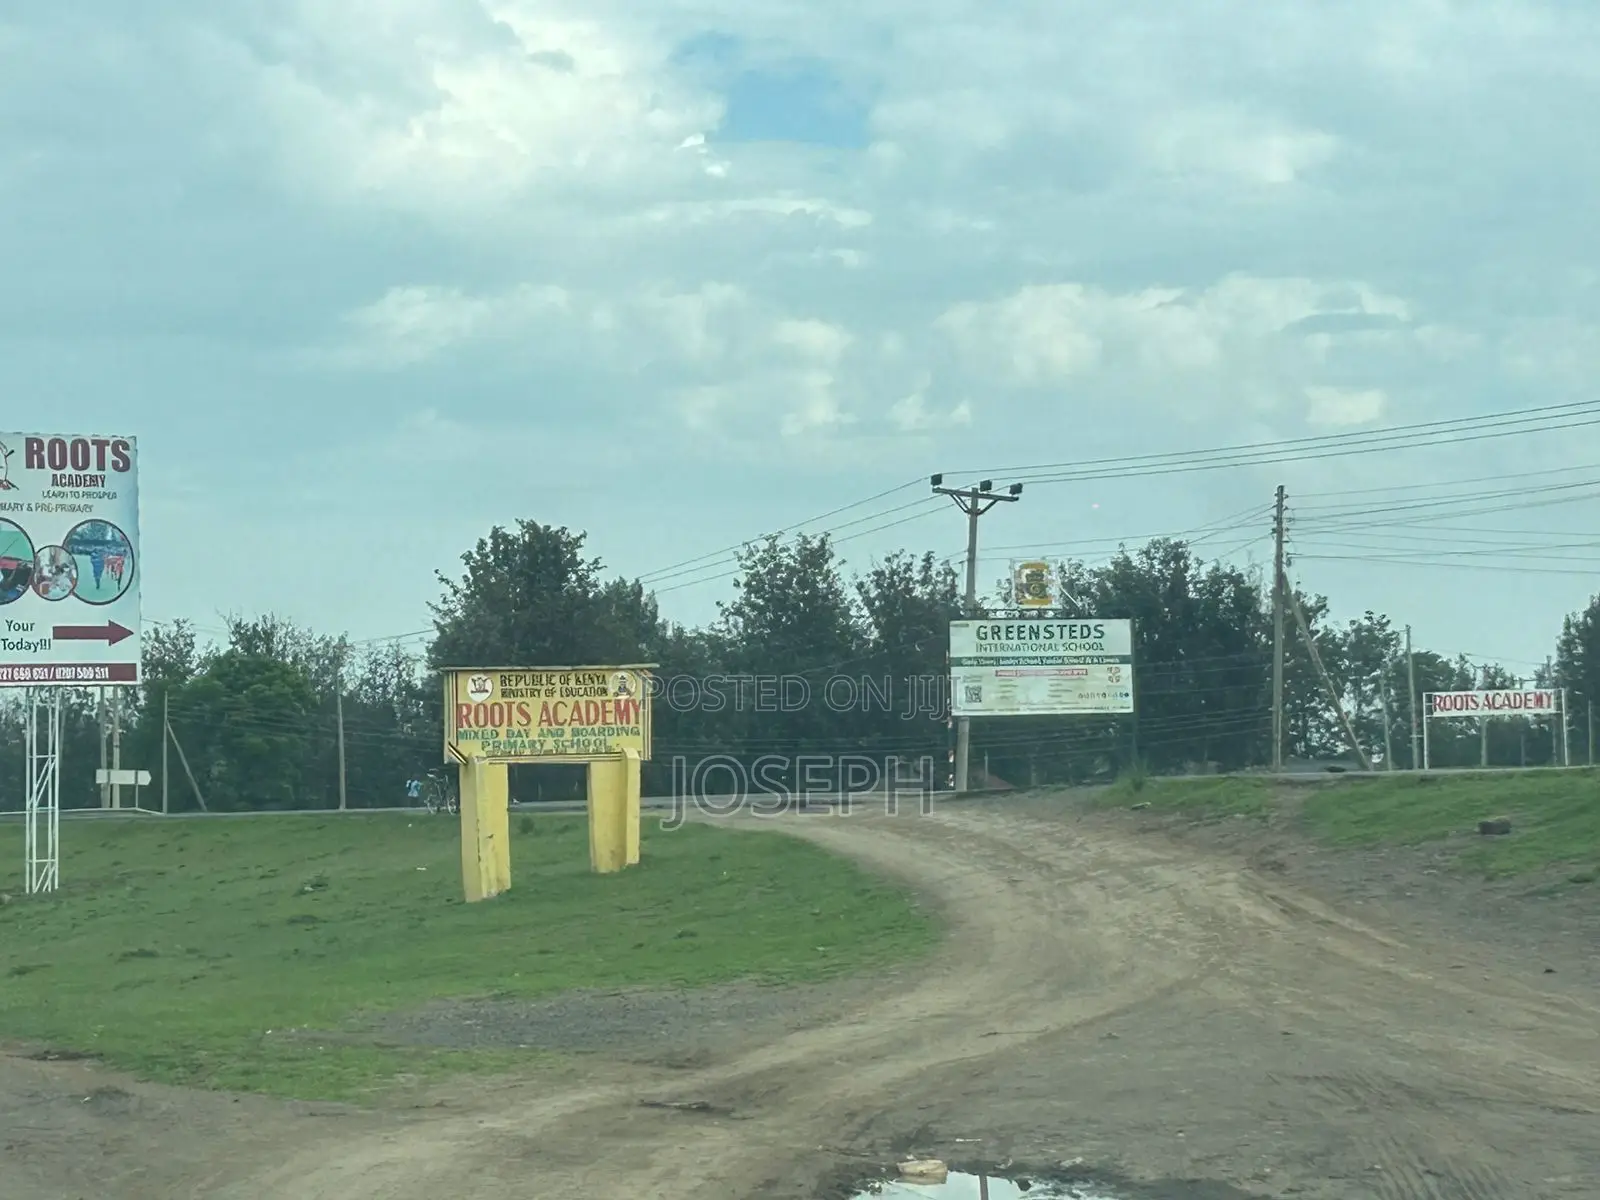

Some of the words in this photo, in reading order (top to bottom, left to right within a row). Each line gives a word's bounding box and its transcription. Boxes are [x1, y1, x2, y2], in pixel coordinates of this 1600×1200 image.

[25, 437, 131, 472] ROOTS
[51, 474, 106, 488] ACADEMY
[69, 490, 80, 499] TO
[26, 502, 33, 512] &
[5, 619, 35, 632] Your
[976, 624, 1105, 640] GREENSTEDS
[1, 637, 51, 653] Today!!!
[976, 642, 1059, 653] INTERNATIONAL
[1062, 641, 1105, 652] SCHOOL
[500, 674, 556, 687] REPUBLIC
[559, 674, 571, 686] OF
[575, 673, 607, 685] KENYA
[501, 688, 541, 698] MINISTRY
[545, 687, 557, 698] OF
[560, 687, 608, 698] EDUCATION
[1434, 694, 1479, 712] ROOTS
[1482, 692, 1553, 711] ACADEMY
[457, 701, 532, 728] ROOTS
[538, 698, 641, 727] ACADEMY
[458, 729, 498, 740] MIXED
[506, 728, 531, 739] DAY
[538, 728, 565, 738] AND
[571, 726, 640, 738] BOARDING
[481, 740, 546, 751] PRIMARY
[553, 738, 607, 750] SCHOOL
